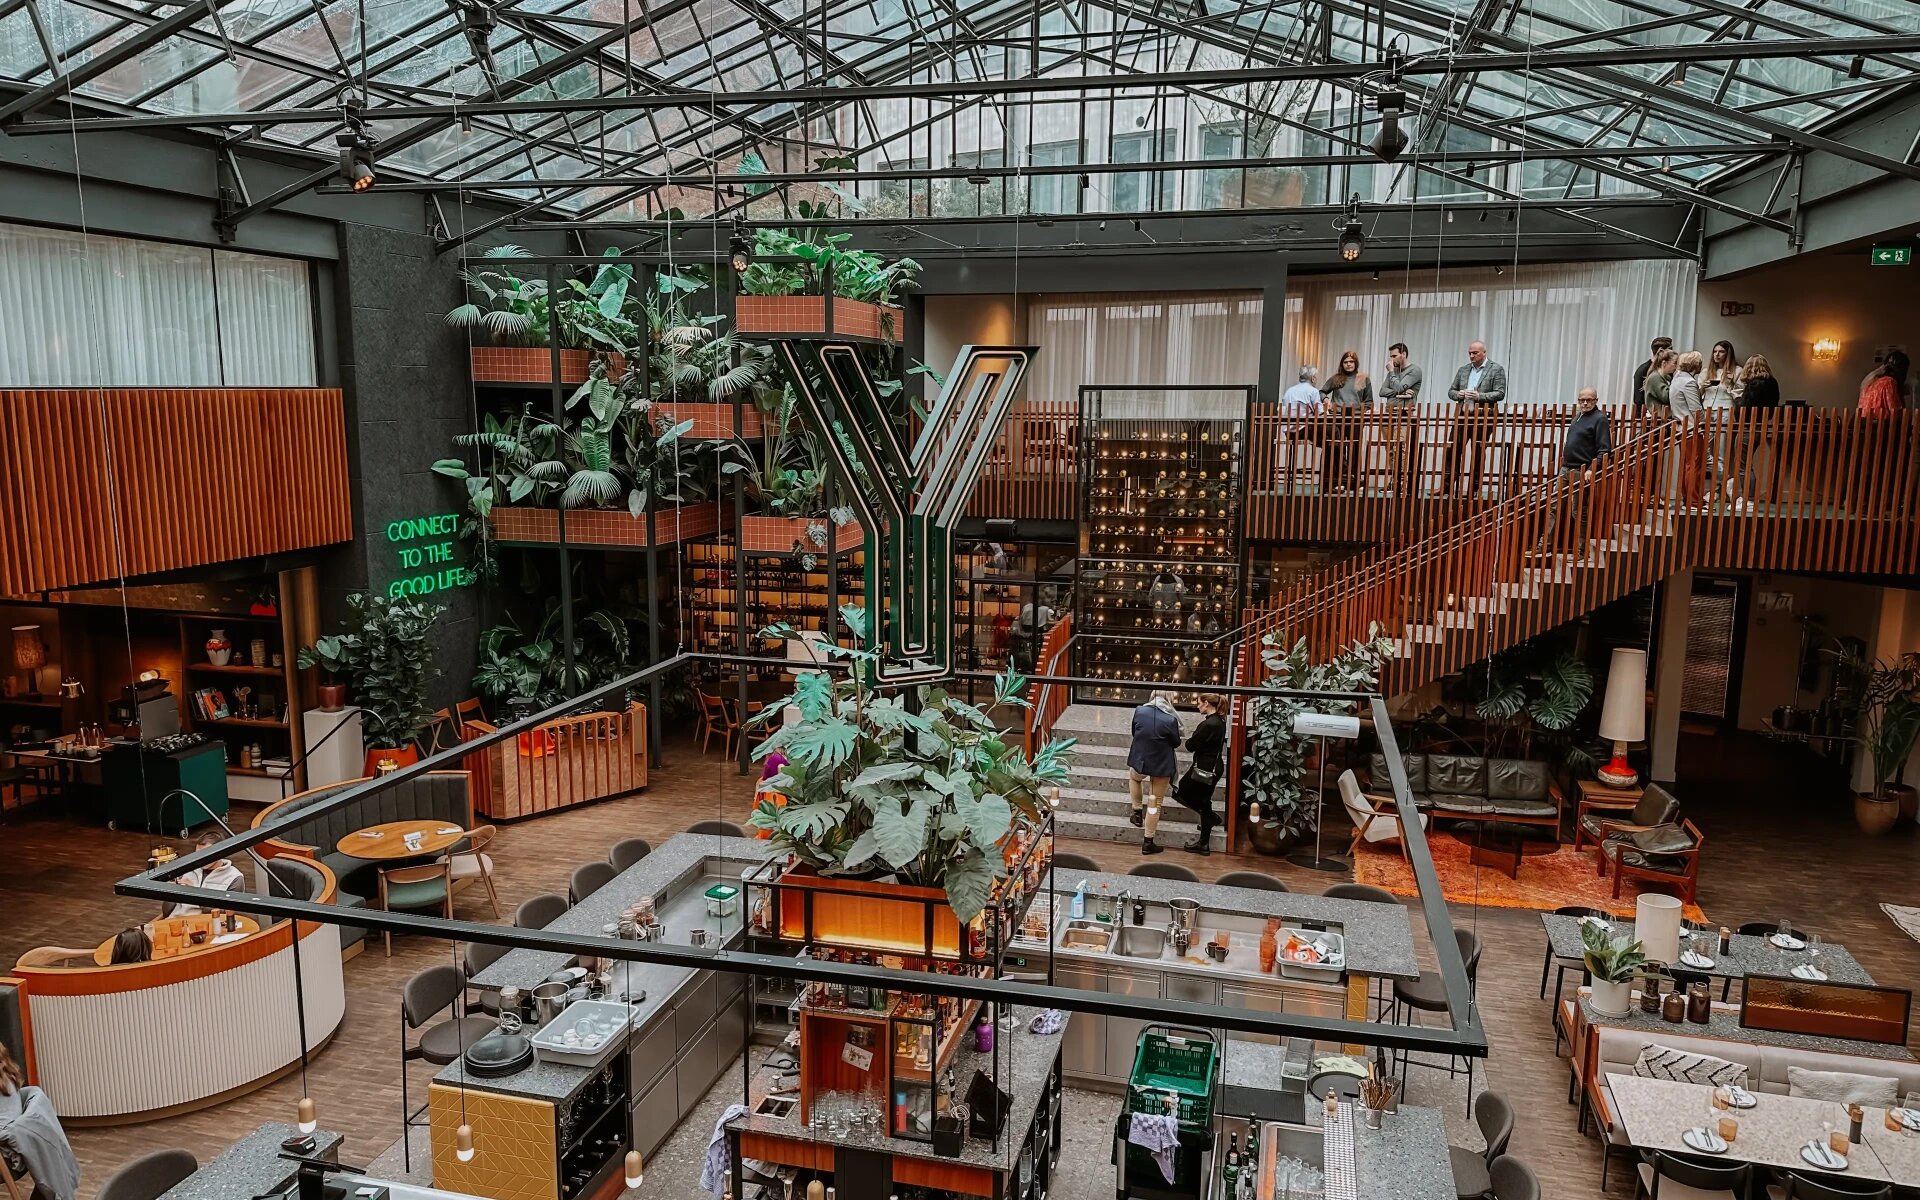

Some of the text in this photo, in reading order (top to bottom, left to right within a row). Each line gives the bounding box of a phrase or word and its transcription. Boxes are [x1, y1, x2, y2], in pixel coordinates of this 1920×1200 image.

[387, 514, 460, 542] CONNECT
[768, 338, 1040, 690] Y
[398, 541, 454, 569] TO THE
[389, 567, 466, 599] GOOD LIFE
